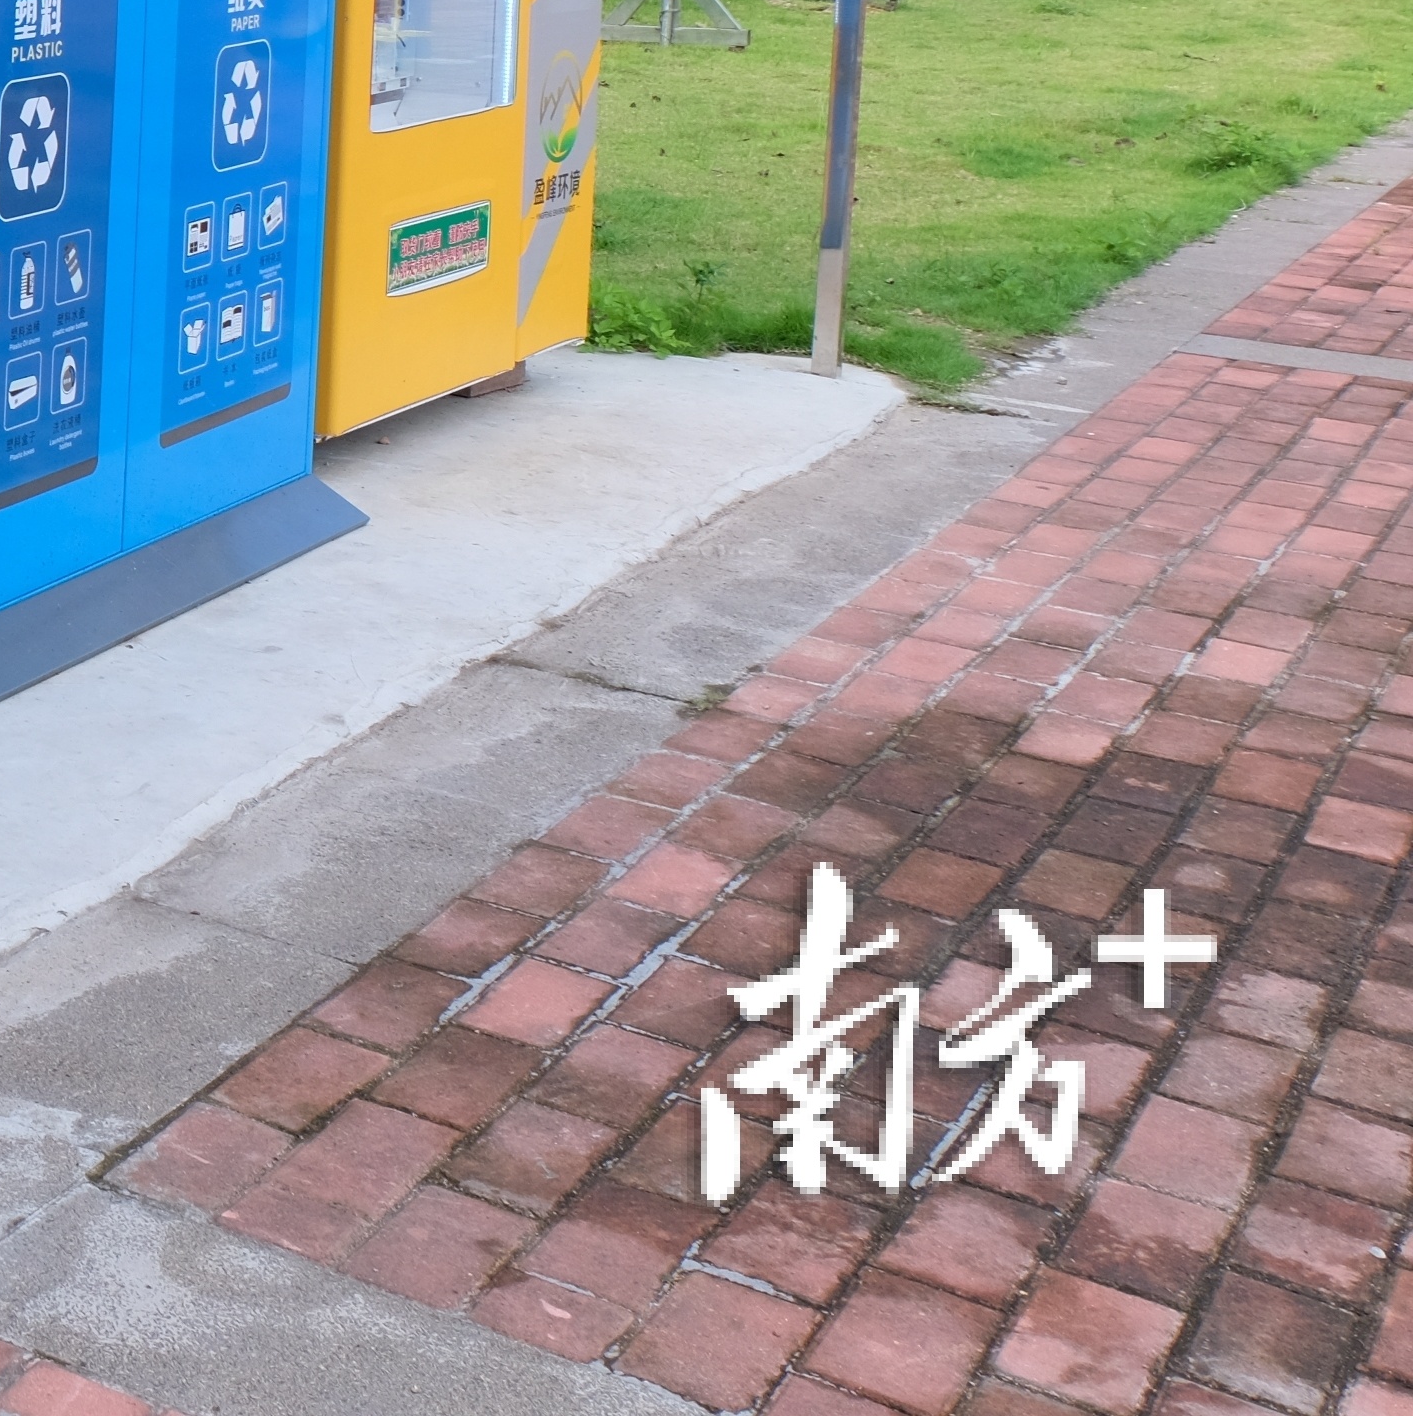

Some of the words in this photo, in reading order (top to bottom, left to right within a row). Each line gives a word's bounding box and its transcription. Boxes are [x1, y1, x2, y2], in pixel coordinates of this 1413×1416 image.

[231, 13, 260, 33] PAPER
[11, 40, 64, 63] PLASTIC
[534, 169, 581, 206] 盈峰环境
